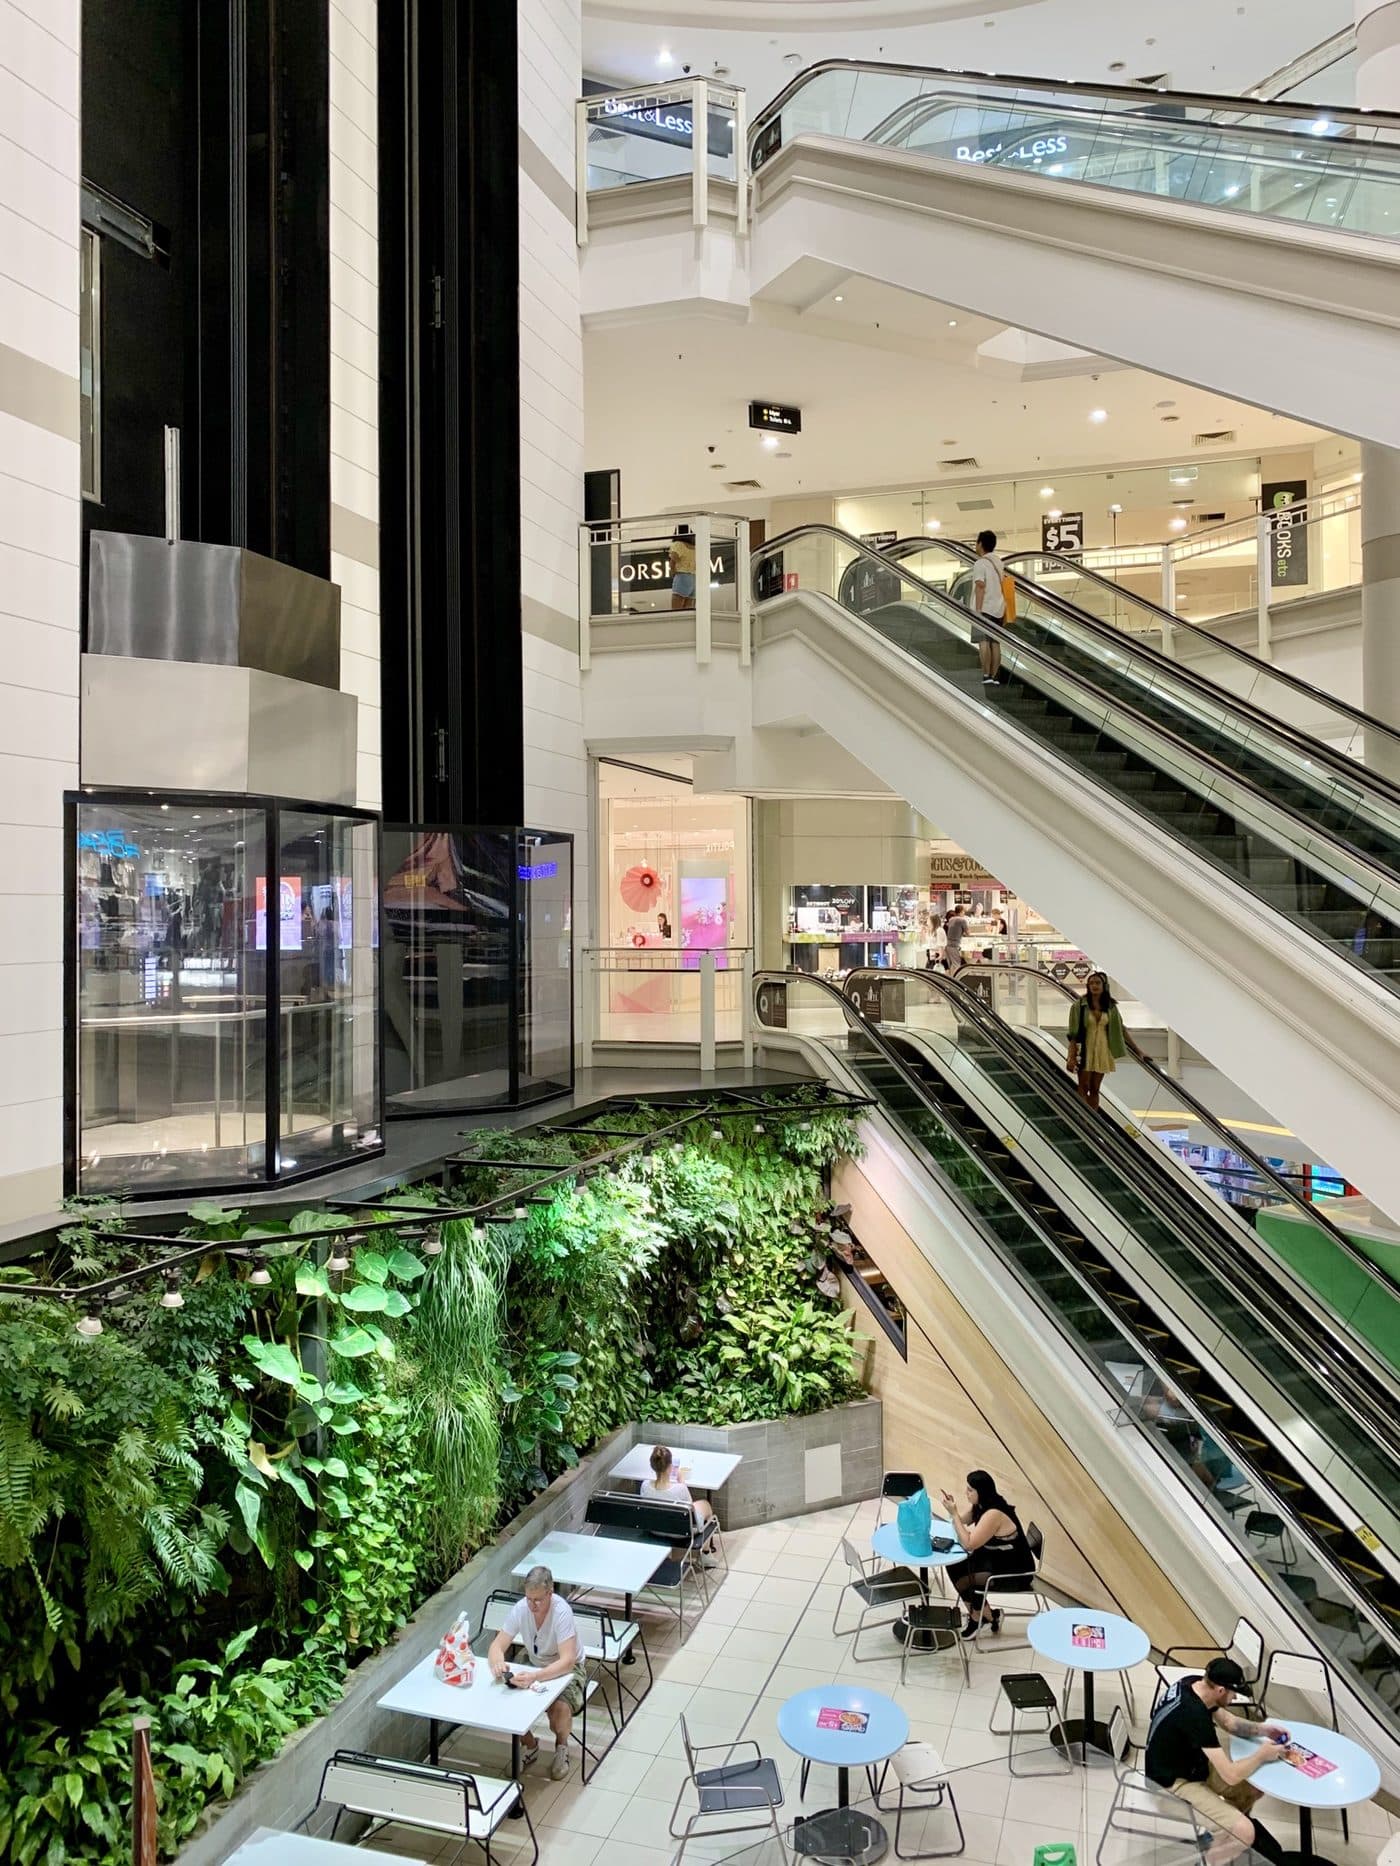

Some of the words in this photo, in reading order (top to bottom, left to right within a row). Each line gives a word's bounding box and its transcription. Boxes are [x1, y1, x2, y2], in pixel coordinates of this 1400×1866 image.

[755, 151, 763, 166] 2
[1046, 524, 1081, 551] $5
[1277, 559, 1289, 577] etc
[760, 995, 768, 1013] Q
[851, 991, 861, 1009] Q
